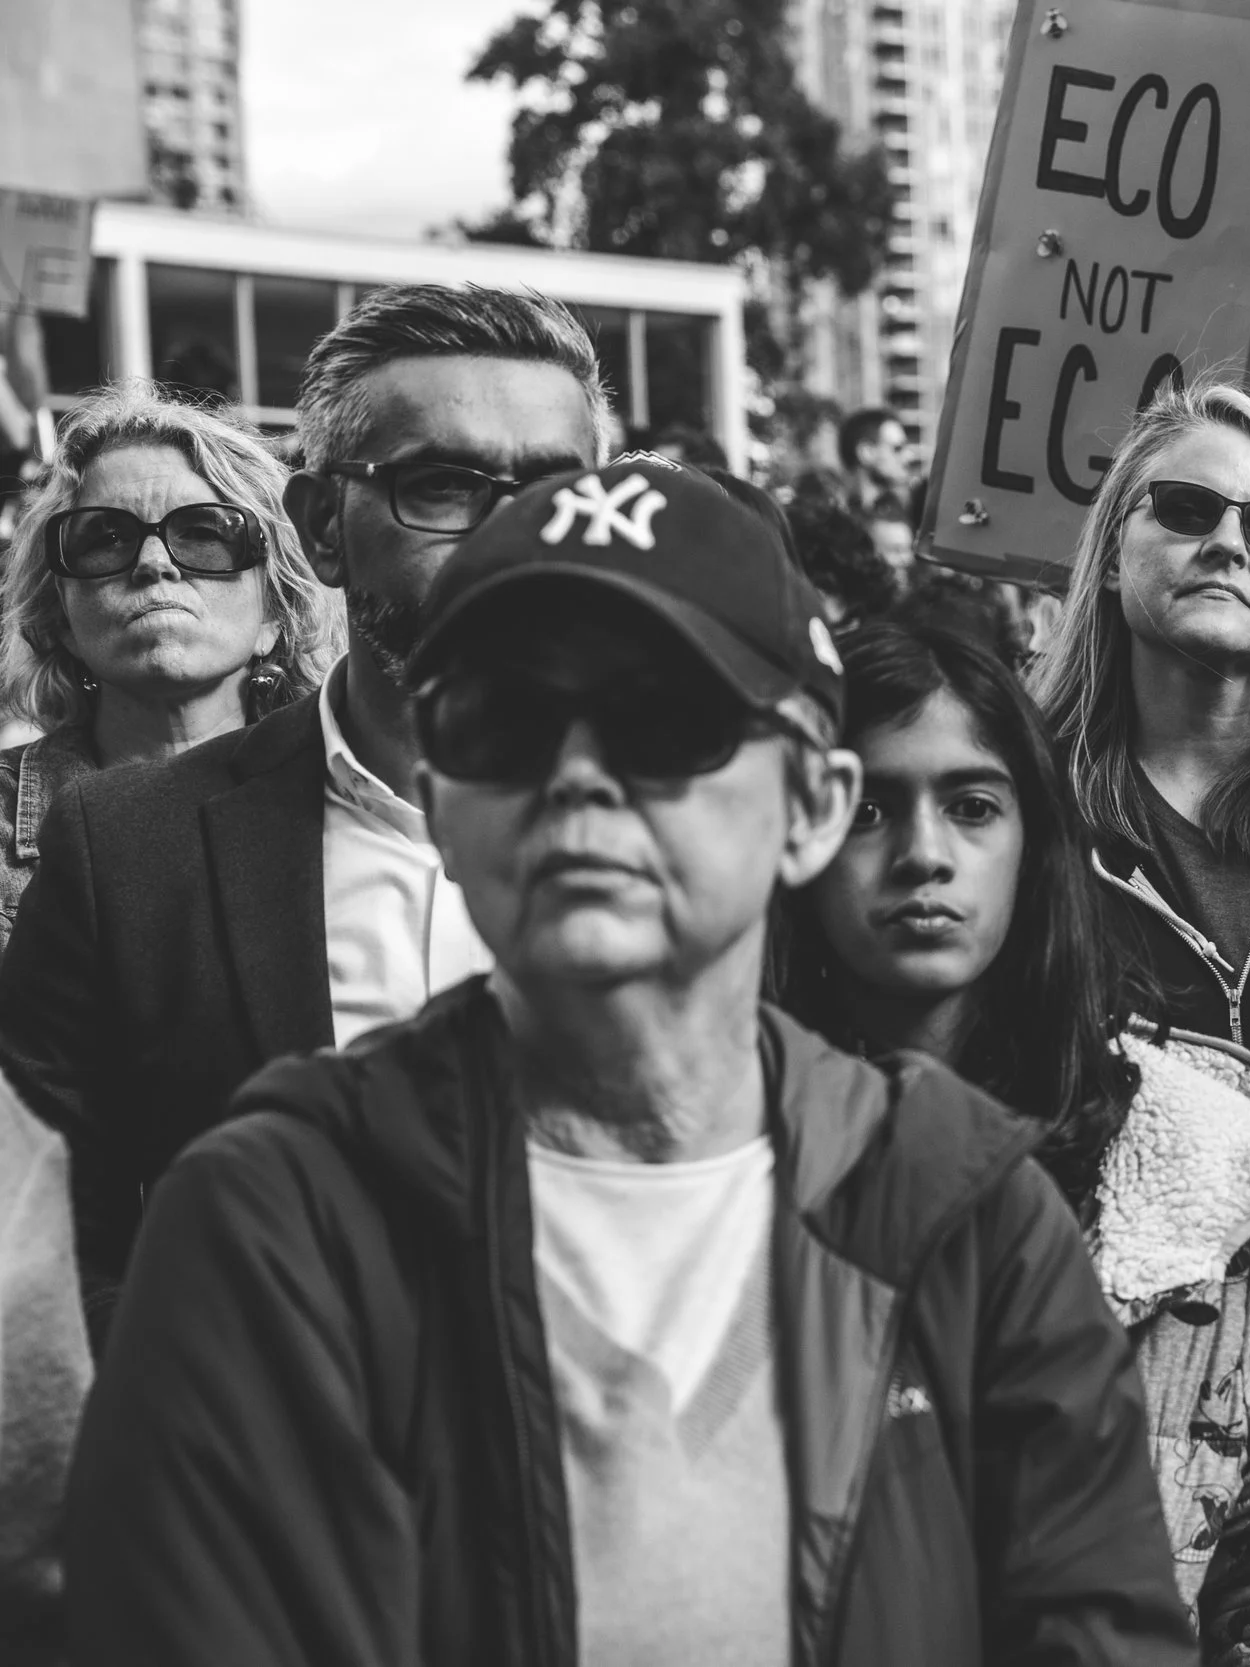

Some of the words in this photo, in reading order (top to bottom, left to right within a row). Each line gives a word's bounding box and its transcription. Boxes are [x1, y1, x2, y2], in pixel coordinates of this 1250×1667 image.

[1036, 64, 1221, 240] ECO
[1059, 258, 1174, 334] NOT
[980, 326, 1185, 507] EG
